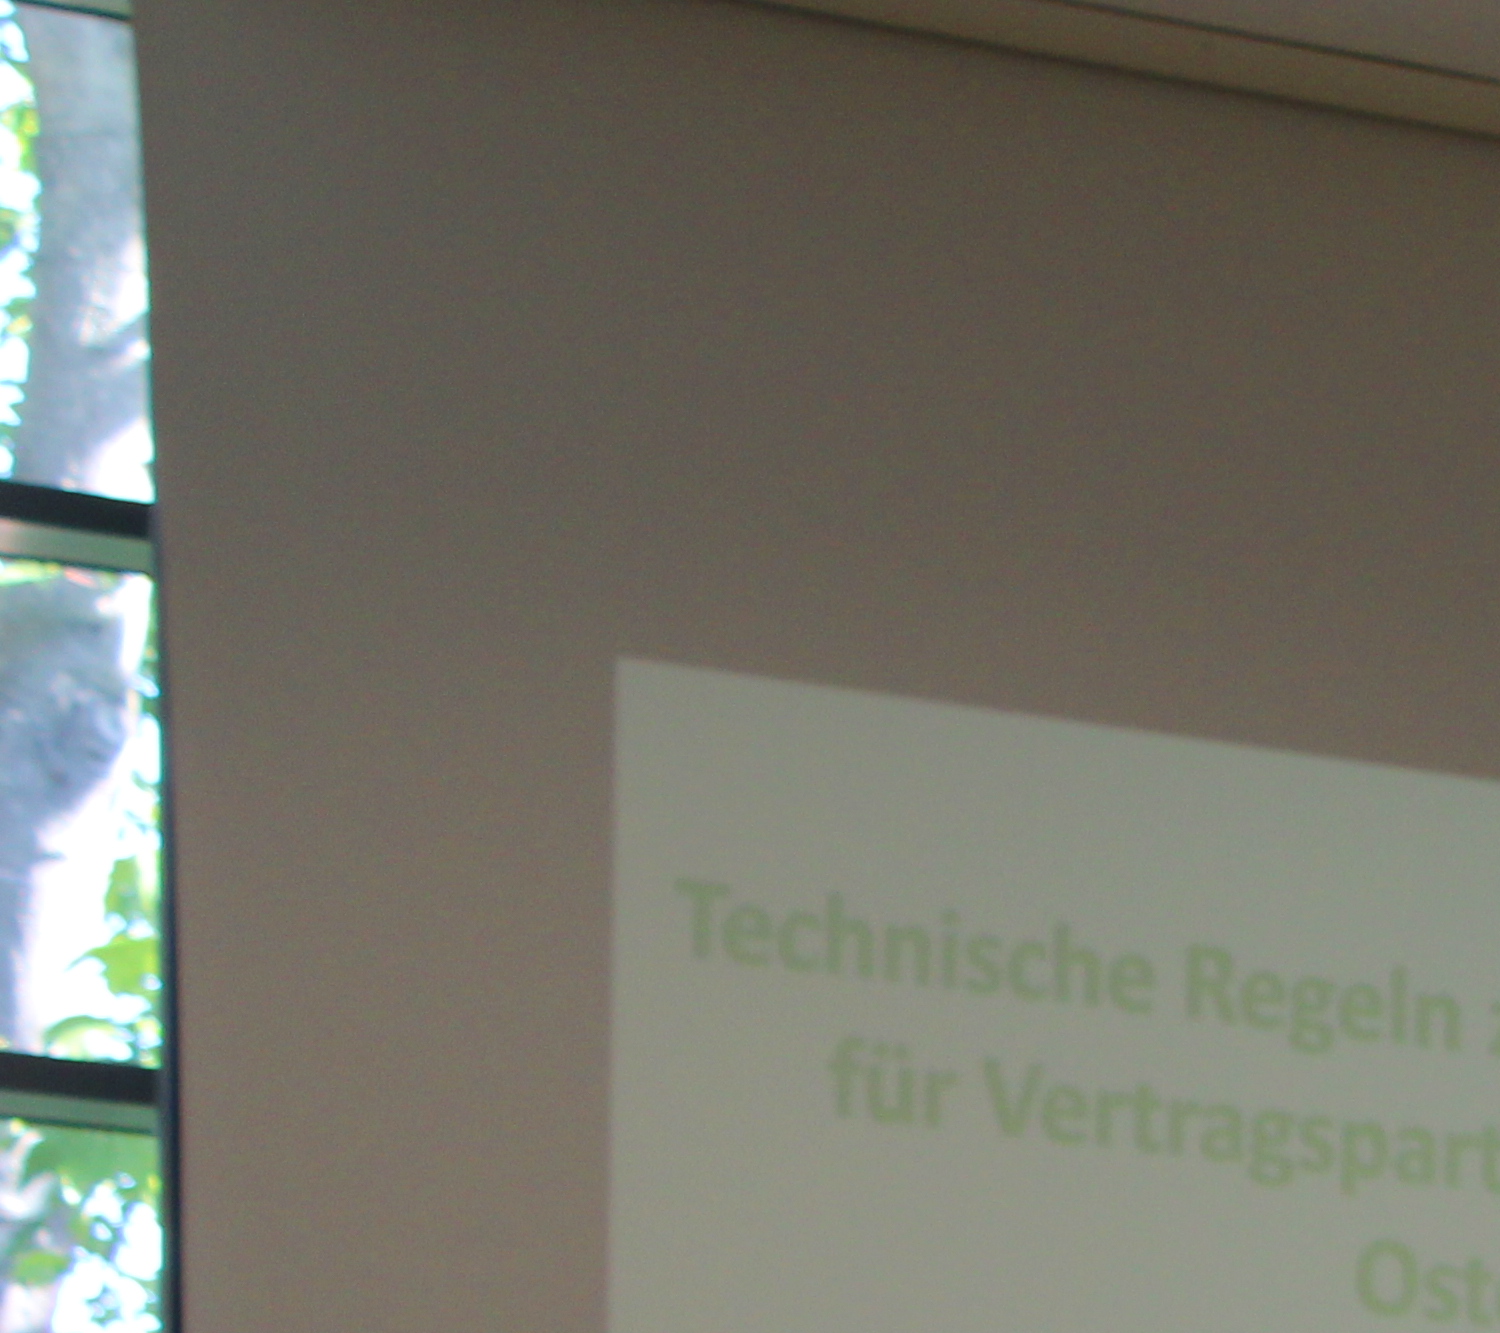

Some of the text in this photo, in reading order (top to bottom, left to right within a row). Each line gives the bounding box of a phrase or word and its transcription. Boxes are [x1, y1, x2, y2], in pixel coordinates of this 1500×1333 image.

[672, 876, 1156, 1015] Technische
[1183, 942, 1463, 1055] Regeln
[826, 1035, 959, 1128] für
